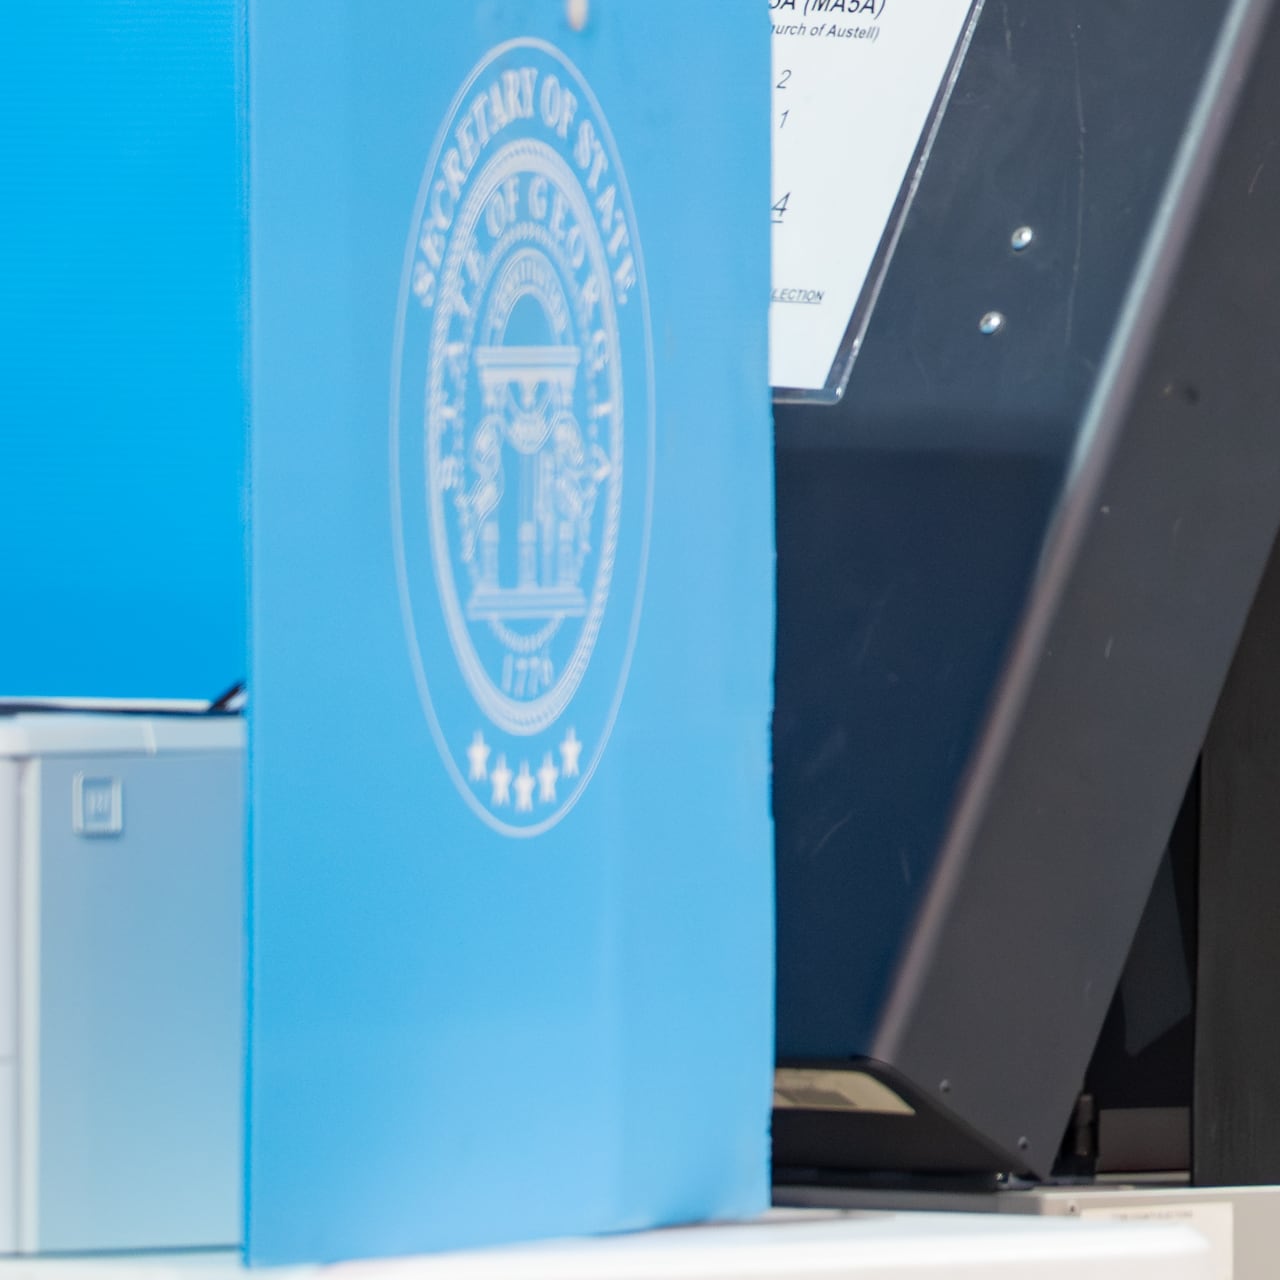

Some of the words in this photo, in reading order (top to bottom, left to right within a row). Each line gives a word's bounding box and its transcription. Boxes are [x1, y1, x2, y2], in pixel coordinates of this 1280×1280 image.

[809, 23, 827, 37] of
[826, 24, 881, 43] Austell)
[776, 68, 793, 90] 2
[540, 74, 578, 140] OF
